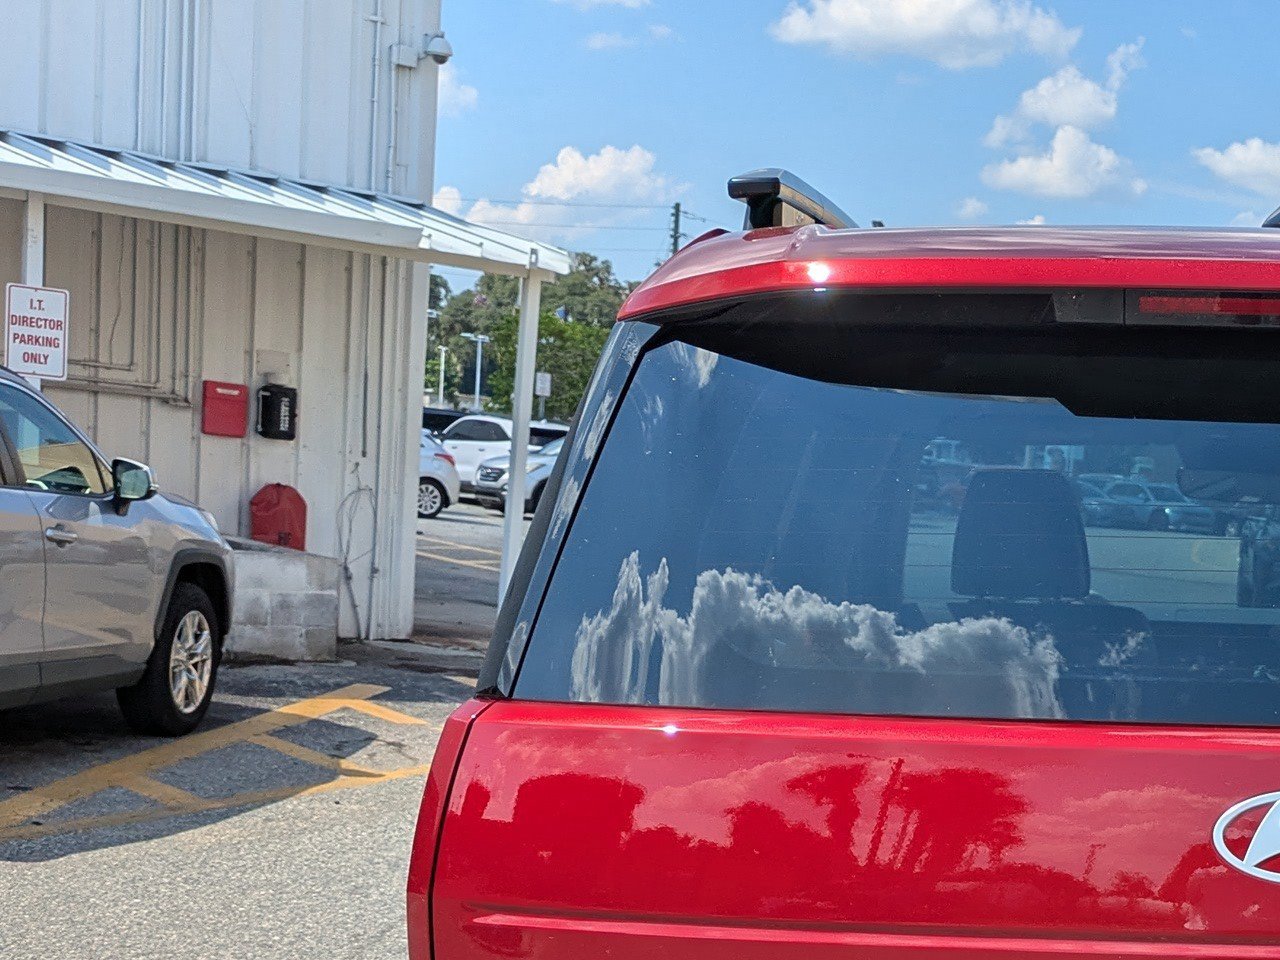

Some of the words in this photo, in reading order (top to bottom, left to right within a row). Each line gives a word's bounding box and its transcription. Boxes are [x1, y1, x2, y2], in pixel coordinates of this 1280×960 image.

[29, 299, 45, 311] I.T.
[10, 314, 63, 331] DIRECTOR
[13, 333, 60, 348] PARKING
[22, 352, 49, 365] ONLY
